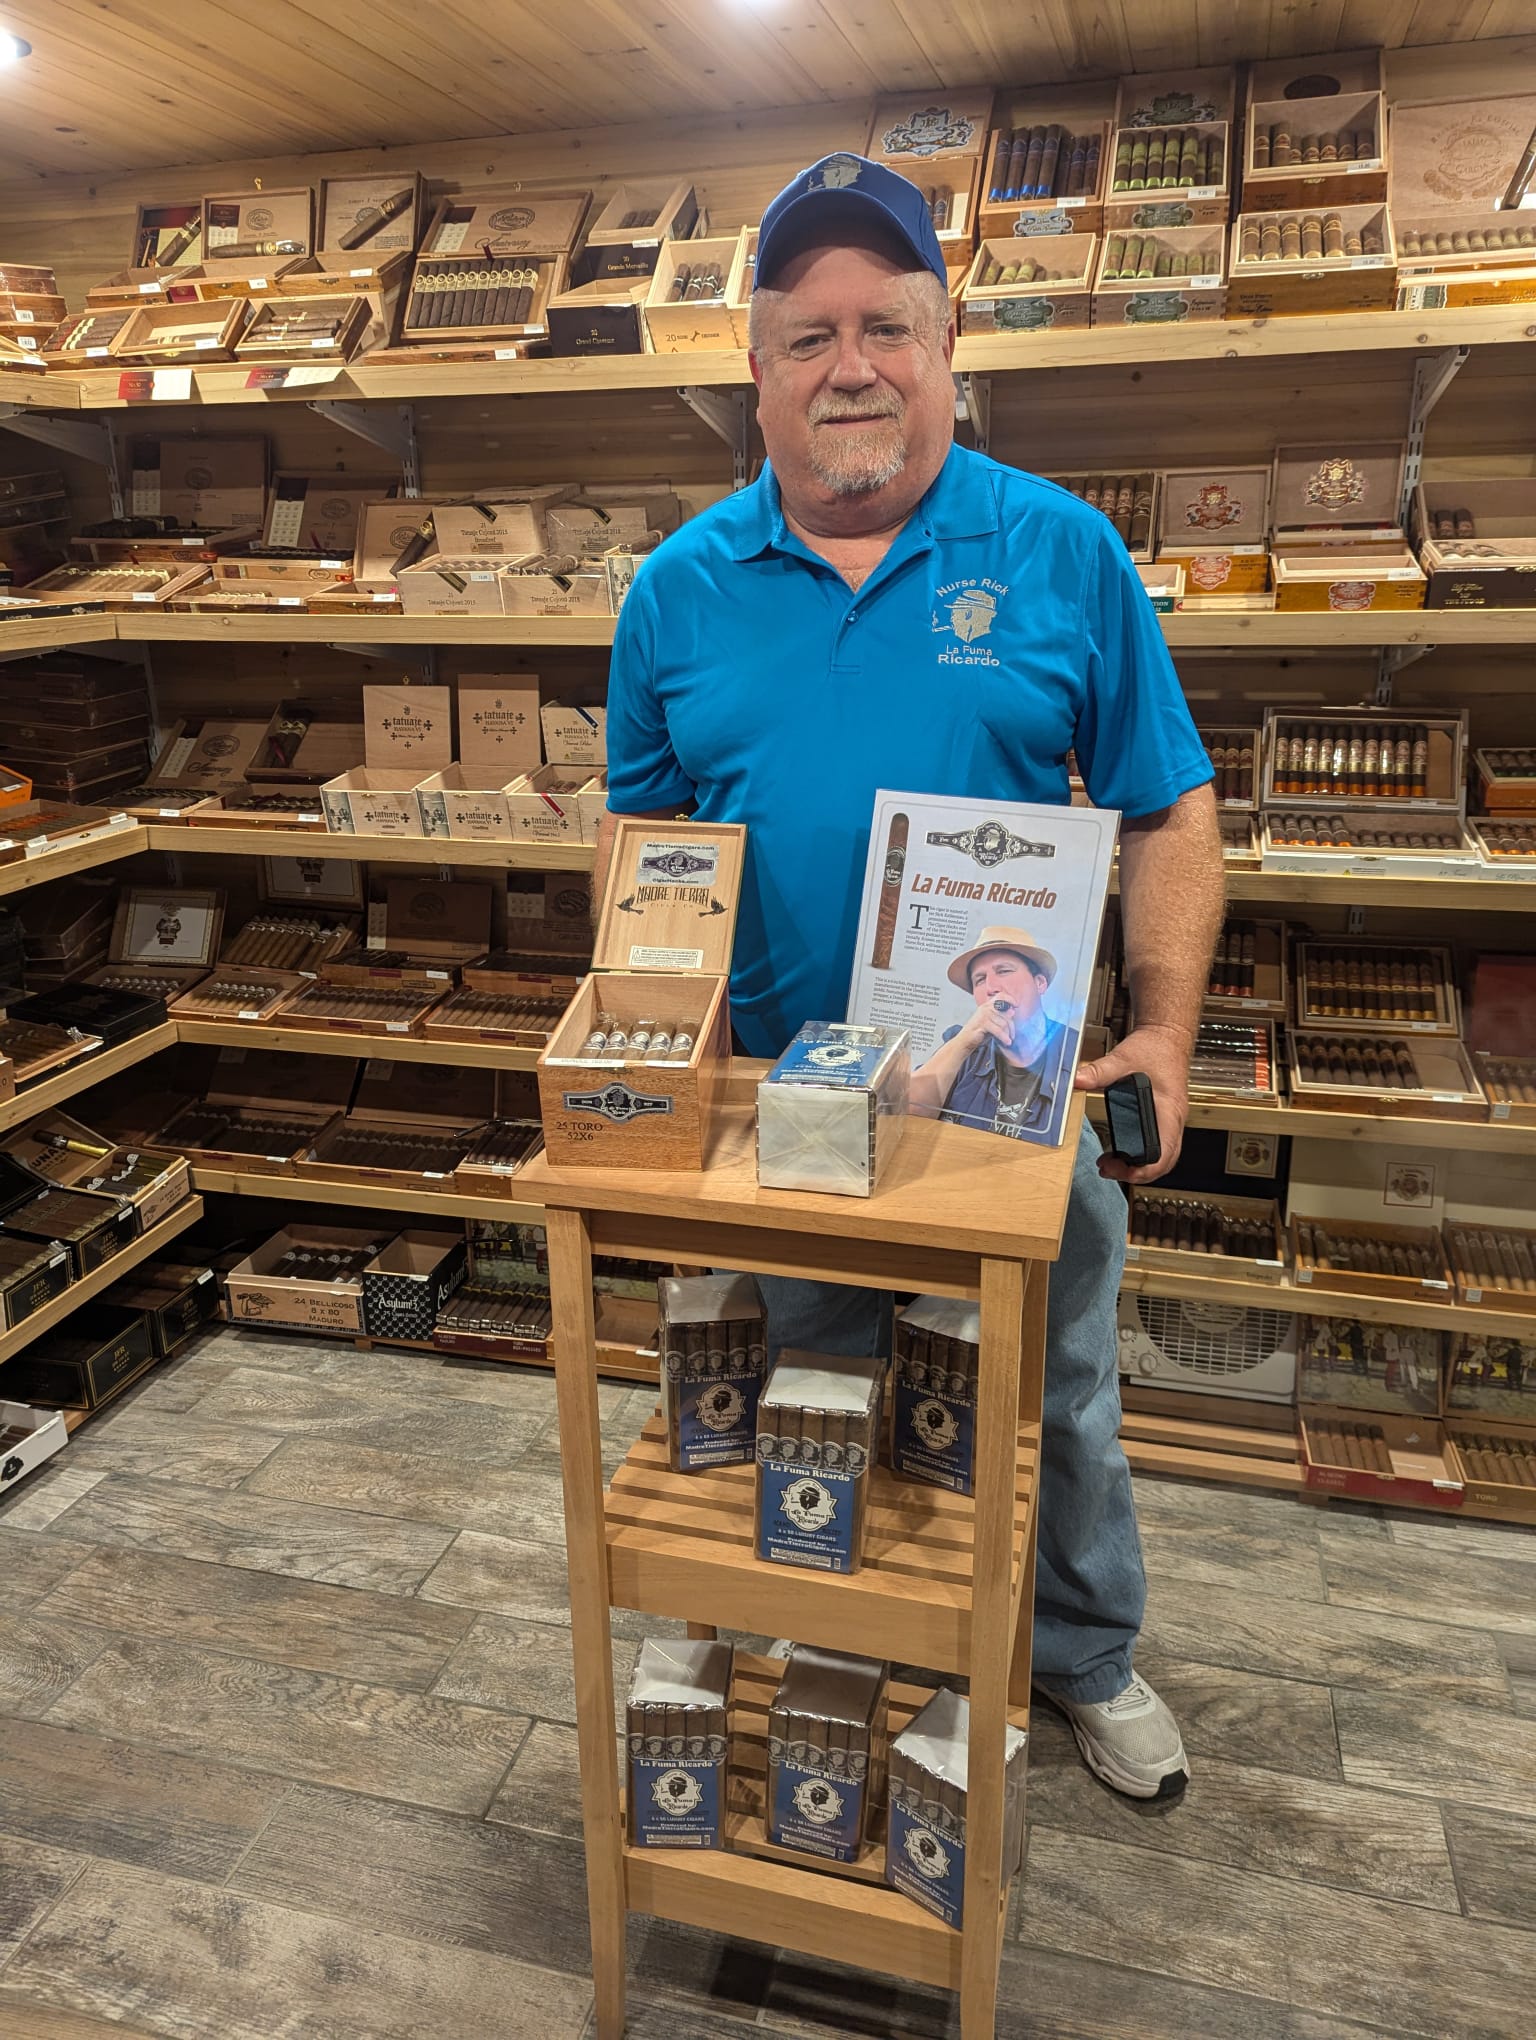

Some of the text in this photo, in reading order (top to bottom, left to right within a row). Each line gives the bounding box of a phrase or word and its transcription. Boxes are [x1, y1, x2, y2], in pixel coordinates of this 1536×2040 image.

[936, 578, 1009, 597] Nurse Rick
[946, 645, 992, 656] La Fuma
[937, 654, 1000, 667] Ricardo
[484, 710, 514, 720] tatuaje
[393, 716, 421, 727] tatuaje
[563, 727, 589, 735] tatuaje
[374, 811, 399, 820] tatuaje
[465, 812, 492, 821] tatuaje
[531, 816, 558, 826] tatuaje
[911, 873, 1057, 909] La Fuma Ricardo
[636, 885, 710, 908] MADRE TIERRA
[556, 1121, 603, 1131] 25 TORO
[567, 1132, 594, 1140] 52X6
[294, 1297, 355, 1310] 24 BELLICOSO
[309, 1315, 344, 1325] MADURO
[723, 1372, 757, 1381] Ricardo
[913, 1384, 936, 1397] Fuma
[937, 1391, 971, 1408] Ricardo
[770, 1463, 850, 1482] La Fuma Ricardo
[1475, 1494, 1499, 1502] TORO
[679, 1760, 713, 1768] Ricardo
[785, 1761, 858, 1786] La Fuma Ricardo
[896, 1802, 963, 1849] La Fuma Ricardo
